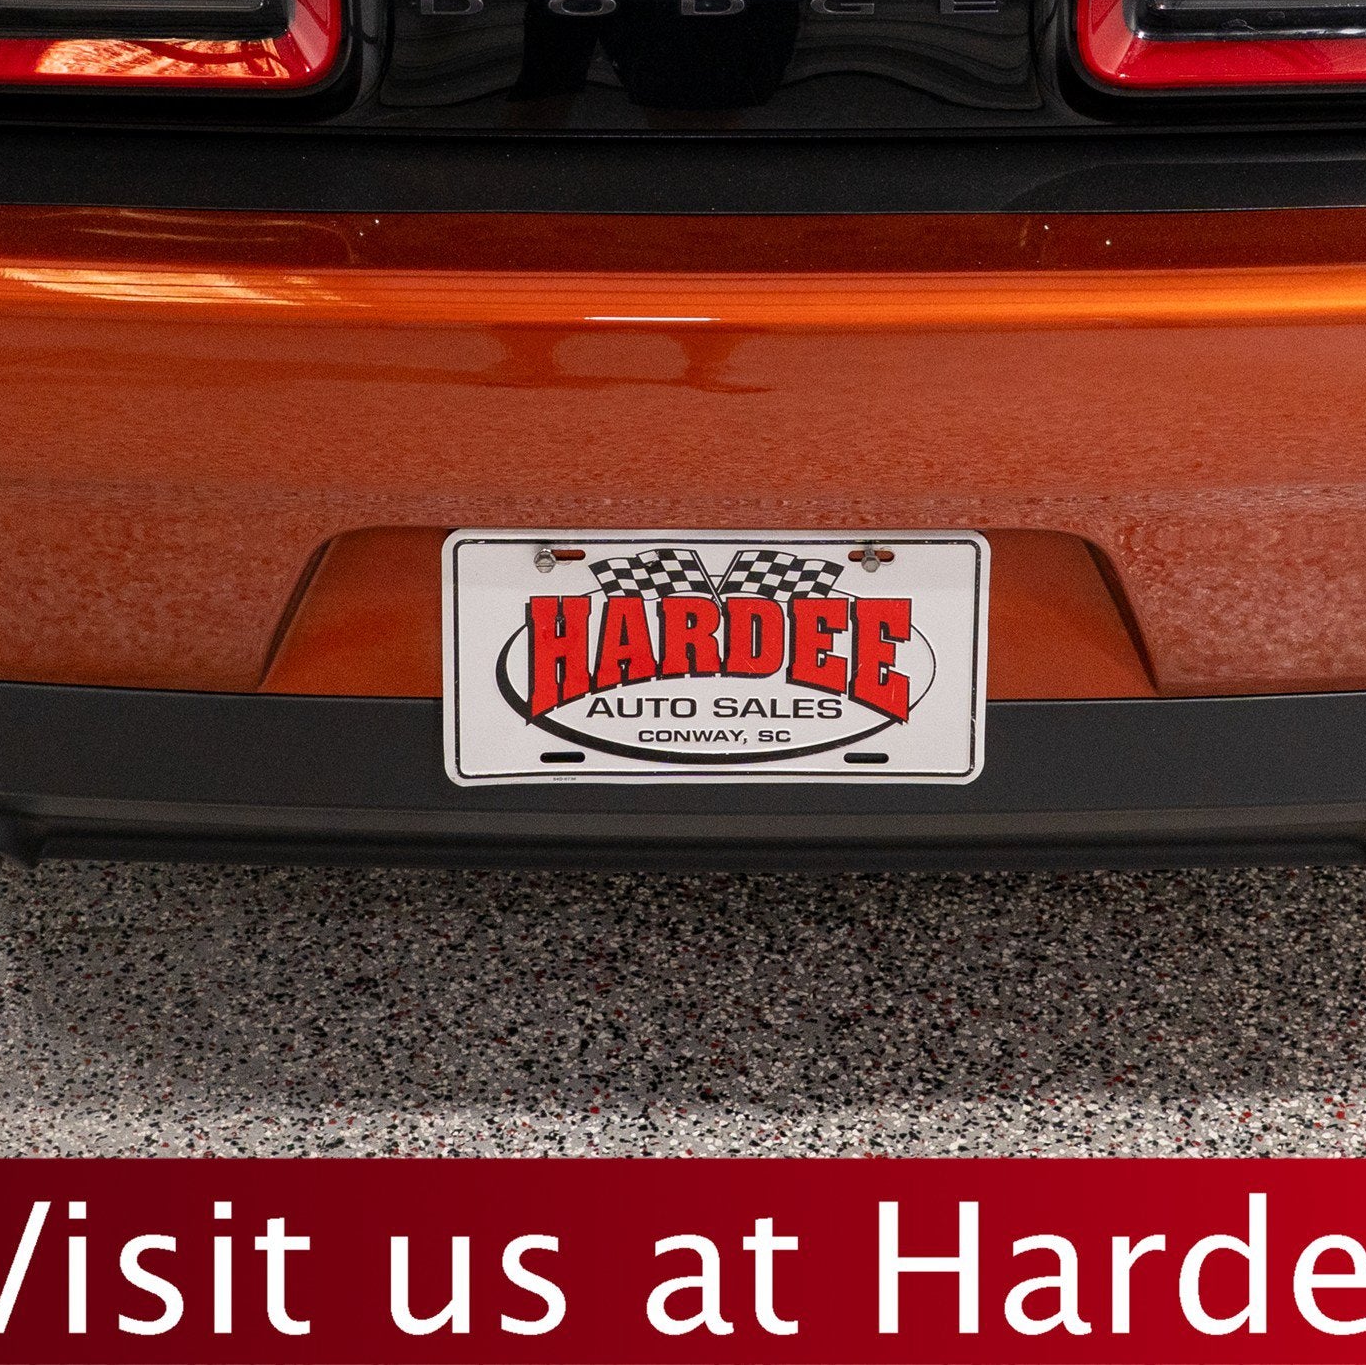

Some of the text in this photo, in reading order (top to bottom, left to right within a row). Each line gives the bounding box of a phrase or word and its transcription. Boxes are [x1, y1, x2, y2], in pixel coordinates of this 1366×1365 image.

[527, 595, 913, 725] HARDEE
[586, 696, 843, 720] AUTO SALES
[637, 729, 792, 746] CONWAY, SC
